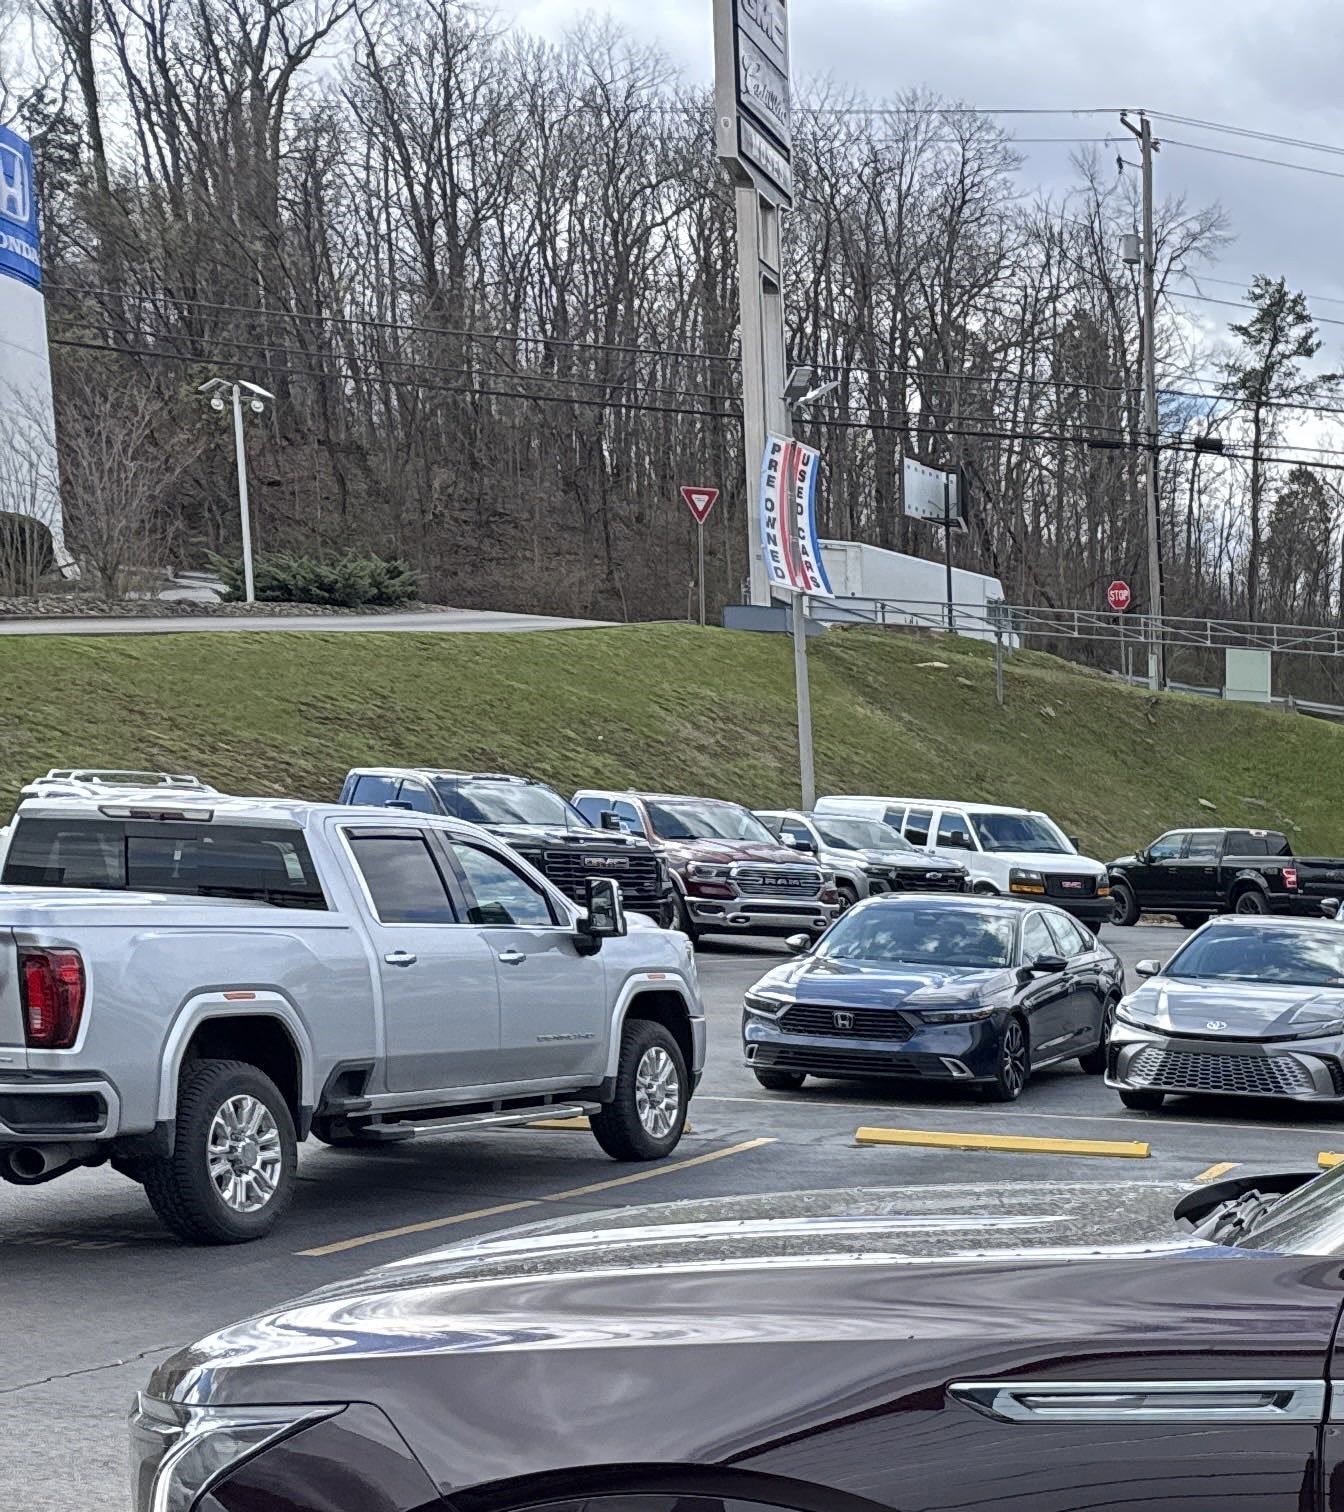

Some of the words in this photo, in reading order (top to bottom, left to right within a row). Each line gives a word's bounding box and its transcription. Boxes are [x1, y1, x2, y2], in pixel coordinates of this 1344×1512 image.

[766, 443, 781, 488] PRE
[797, 453, 810, 516] USED
[798, 527, 821, 588] CARS
[1110, 590, 1128, 600] STOP
